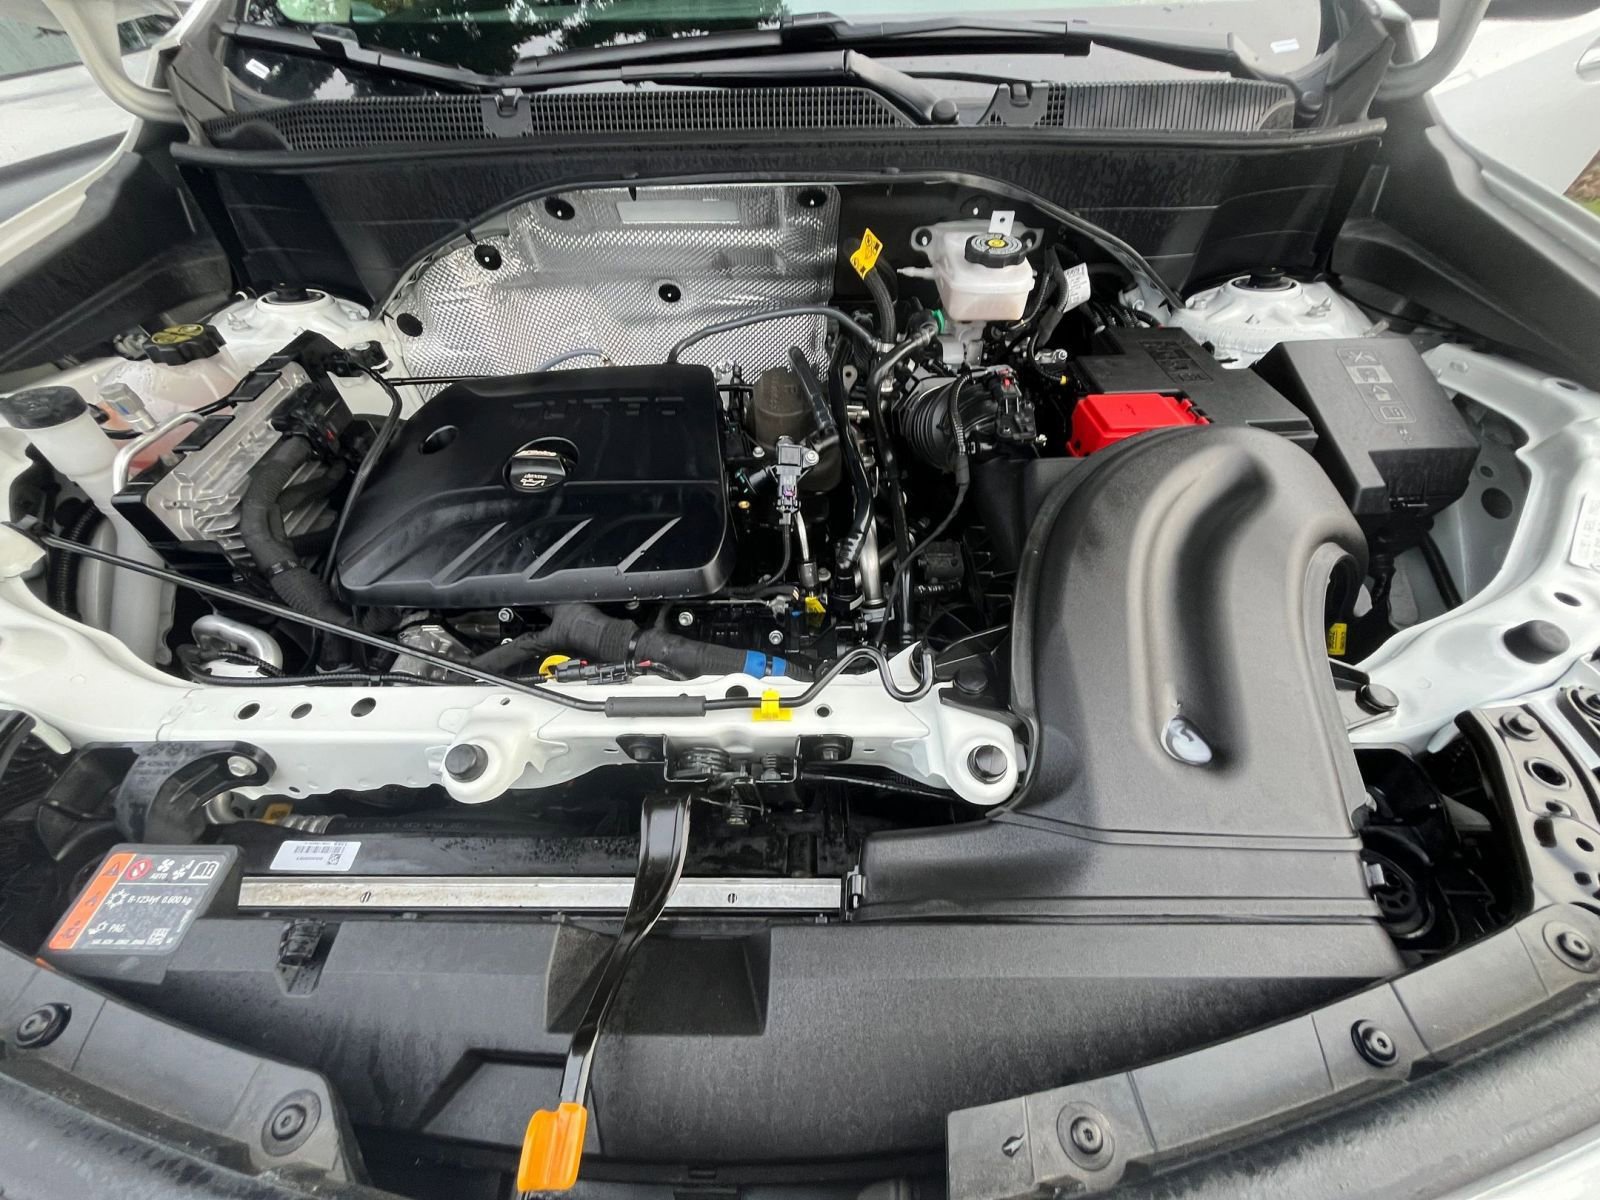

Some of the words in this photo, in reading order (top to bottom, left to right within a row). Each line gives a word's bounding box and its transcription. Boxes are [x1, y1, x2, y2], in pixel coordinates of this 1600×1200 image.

[149, 872, 169, 880] AUTO
[182, 895, 193, 906] kg
[107, 923, 127, 933] PAG
